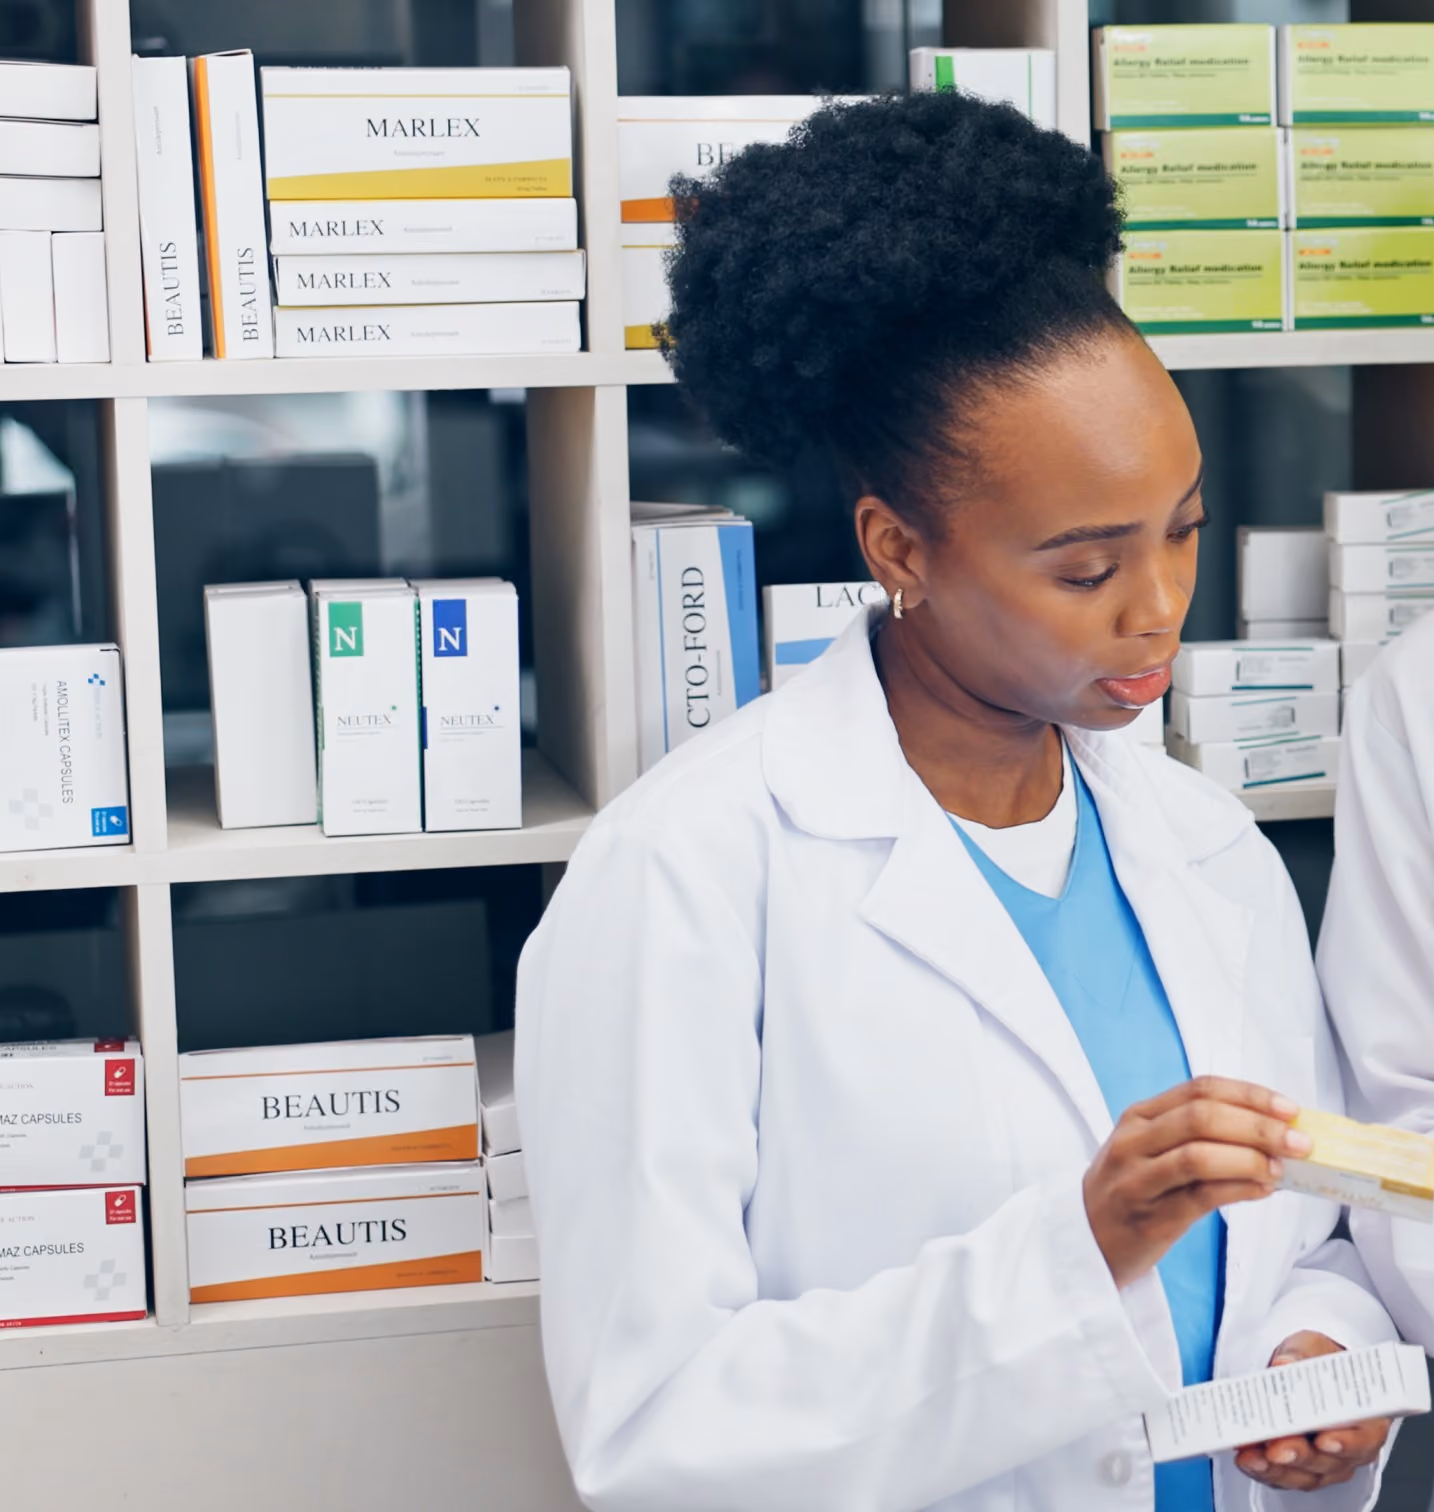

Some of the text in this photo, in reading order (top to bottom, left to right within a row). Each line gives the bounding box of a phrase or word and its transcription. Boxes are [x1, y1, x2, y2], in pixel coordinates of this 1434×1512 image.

[366, 117, 481, 138] MARLEX
[288, 218, 385, 238] MARLEX
[1128, 263, 1263, 275] Allergy Relief medication
[1299, 259, 1432, 271] Allergy Relief medication
[160, 241, 184, 336] BEAUTIS
[297, 271, 392, 290] MARLEX
[237, 246, 259, 341] BEAUTIS
[297, 324, 392, 343] MARLEX
[817, 584, 877, 607] LAC
[334, 626, 358, 651] N
[438, 626, 462, 651] N
[680, 566, 711, 728] CTO-FORD
[337, 714, 392, 727] NEUTEX
[440, 713, 495, 726] NEUTEX
[56, 680, 73, 804] AMOLLITEX CAPSULES
[261, 1089, 401, 1121] BEAUTIS
[21, 1112, 82, 1125] CAPSULES
[268, 1218, 408, 1251] BEAUTIS
[23, 1242, 85, 1257] CAPSULES
